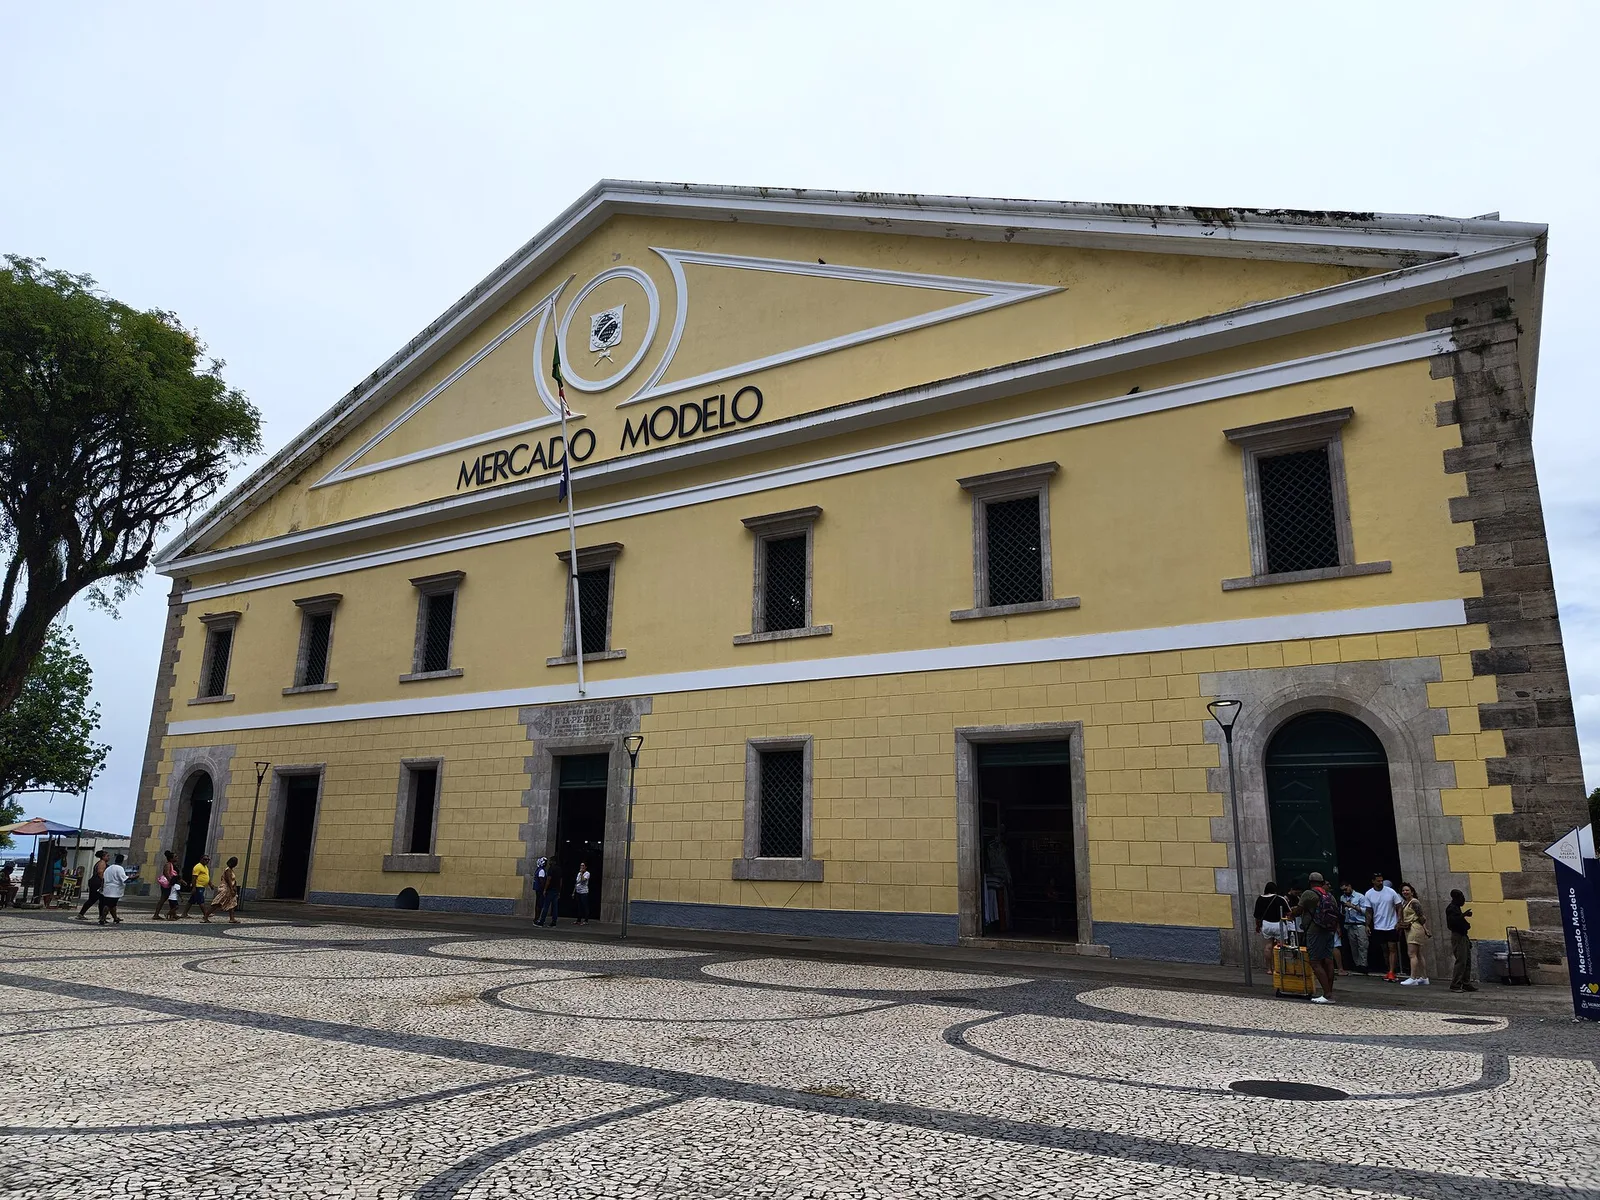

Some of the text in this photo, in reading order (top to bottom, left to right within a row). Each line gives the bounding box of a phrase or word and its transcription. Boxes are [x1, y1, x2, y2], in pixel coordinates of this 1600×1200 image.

[456, 385, 764, 490] MERCADO MODELO
[1568, 887, 1587, 975] Mercado Modelo
